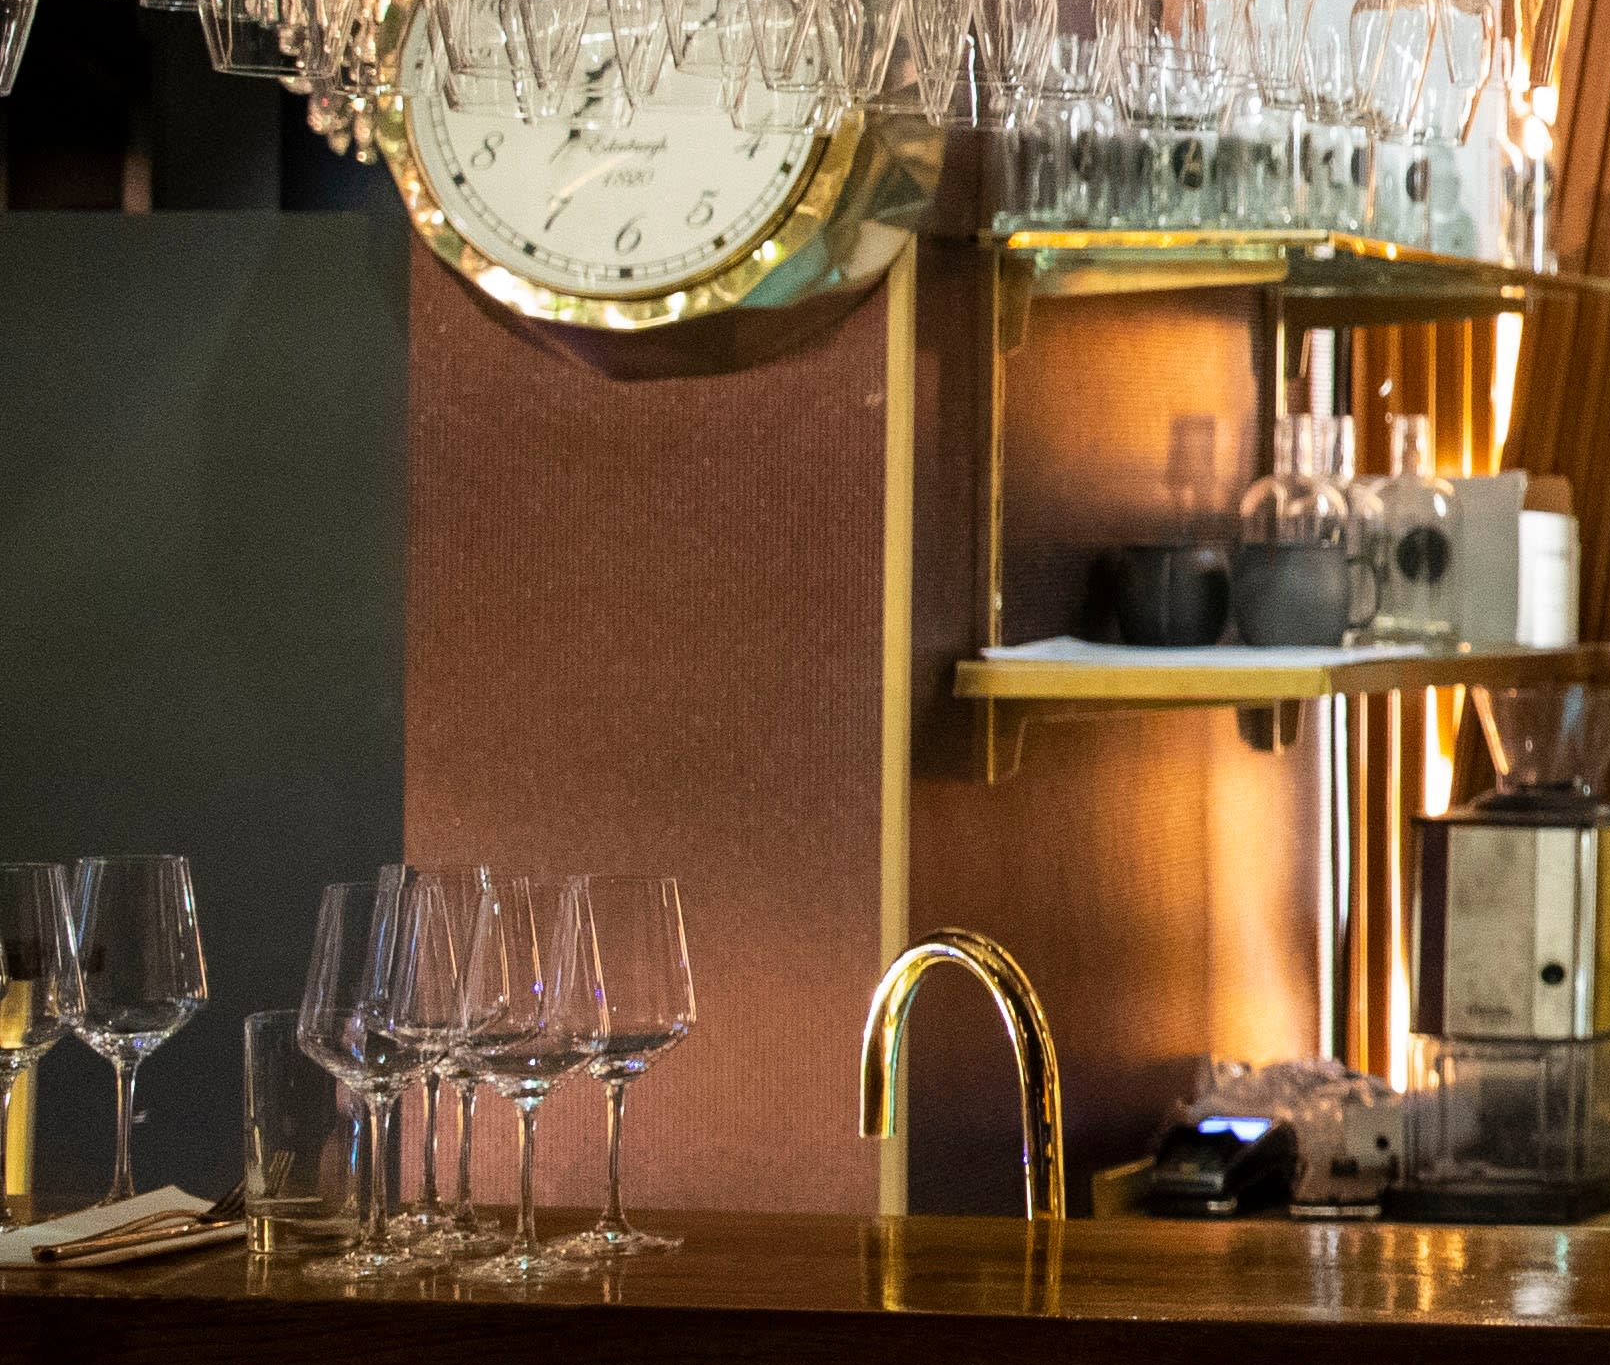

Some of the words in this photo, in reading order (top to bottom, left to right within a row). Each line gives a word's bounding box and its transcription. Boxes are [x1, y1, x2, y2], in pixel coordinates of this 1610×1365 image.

[470, 131, 506, 170] 8
[686, 190, 717, 228] 5
[615, 216, 643, 253] 6
